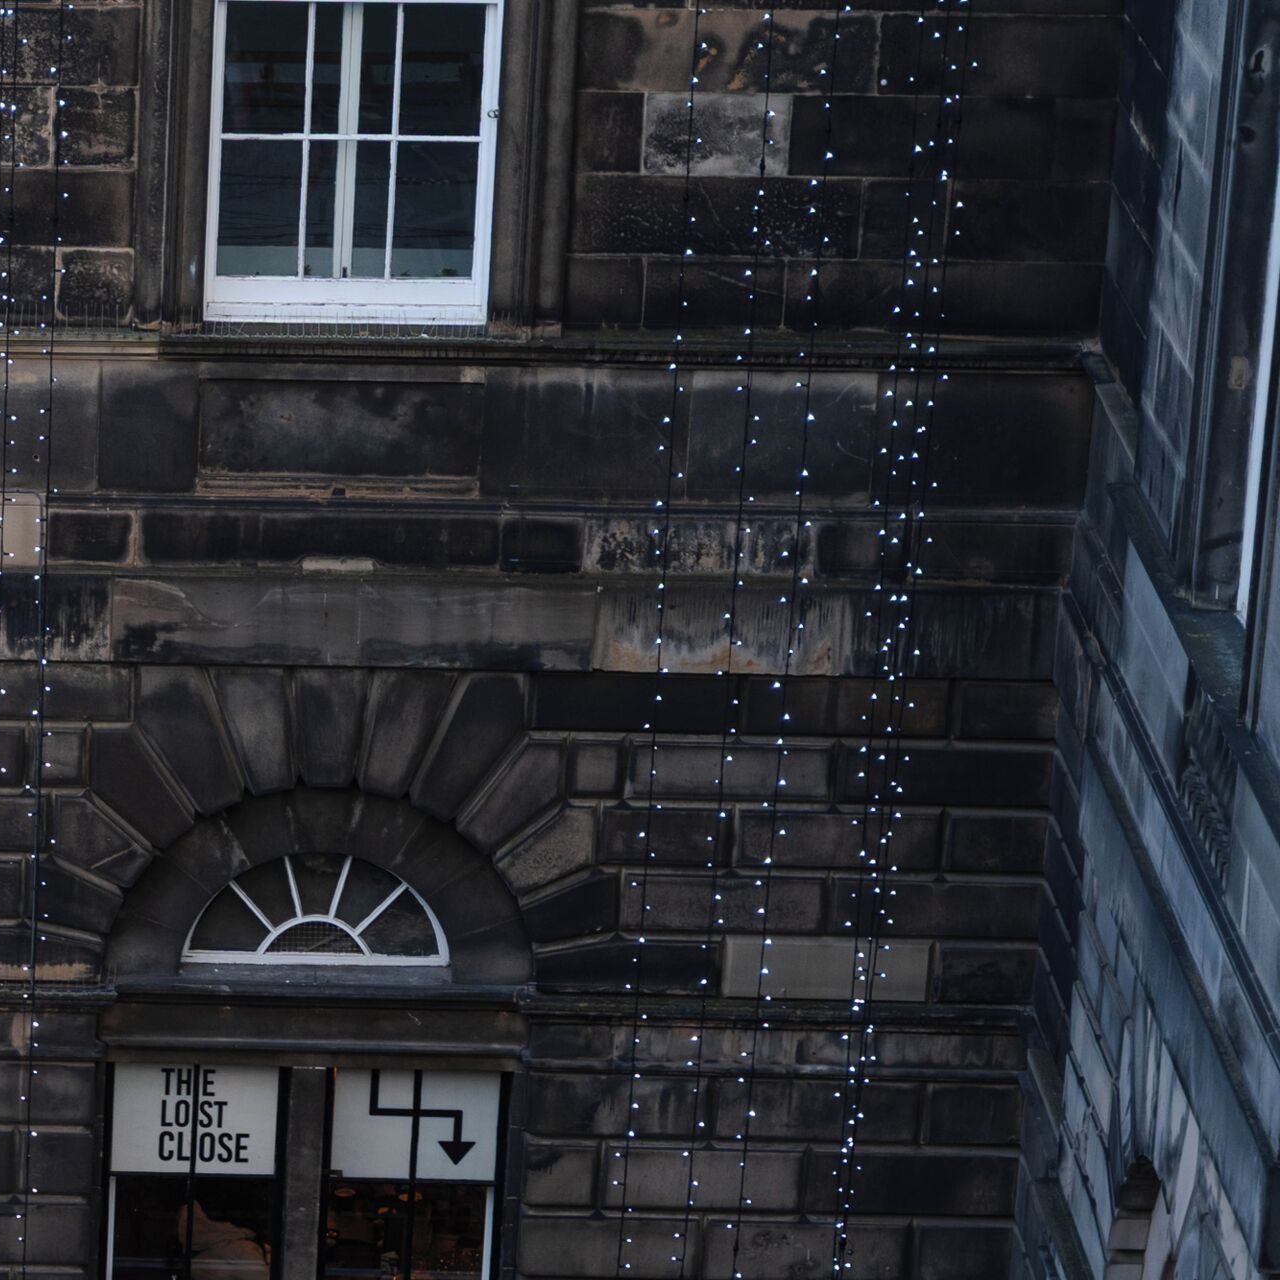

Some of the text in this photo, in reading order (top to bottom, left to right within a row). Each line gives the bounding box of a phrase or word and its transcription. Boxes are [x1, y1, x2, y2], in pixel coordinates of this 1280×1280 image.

[161, 1068, 216, 1097] THE
[160, 1099, 228, 1128] LOST
[158, 1131, 250, 1163] CLOSE
